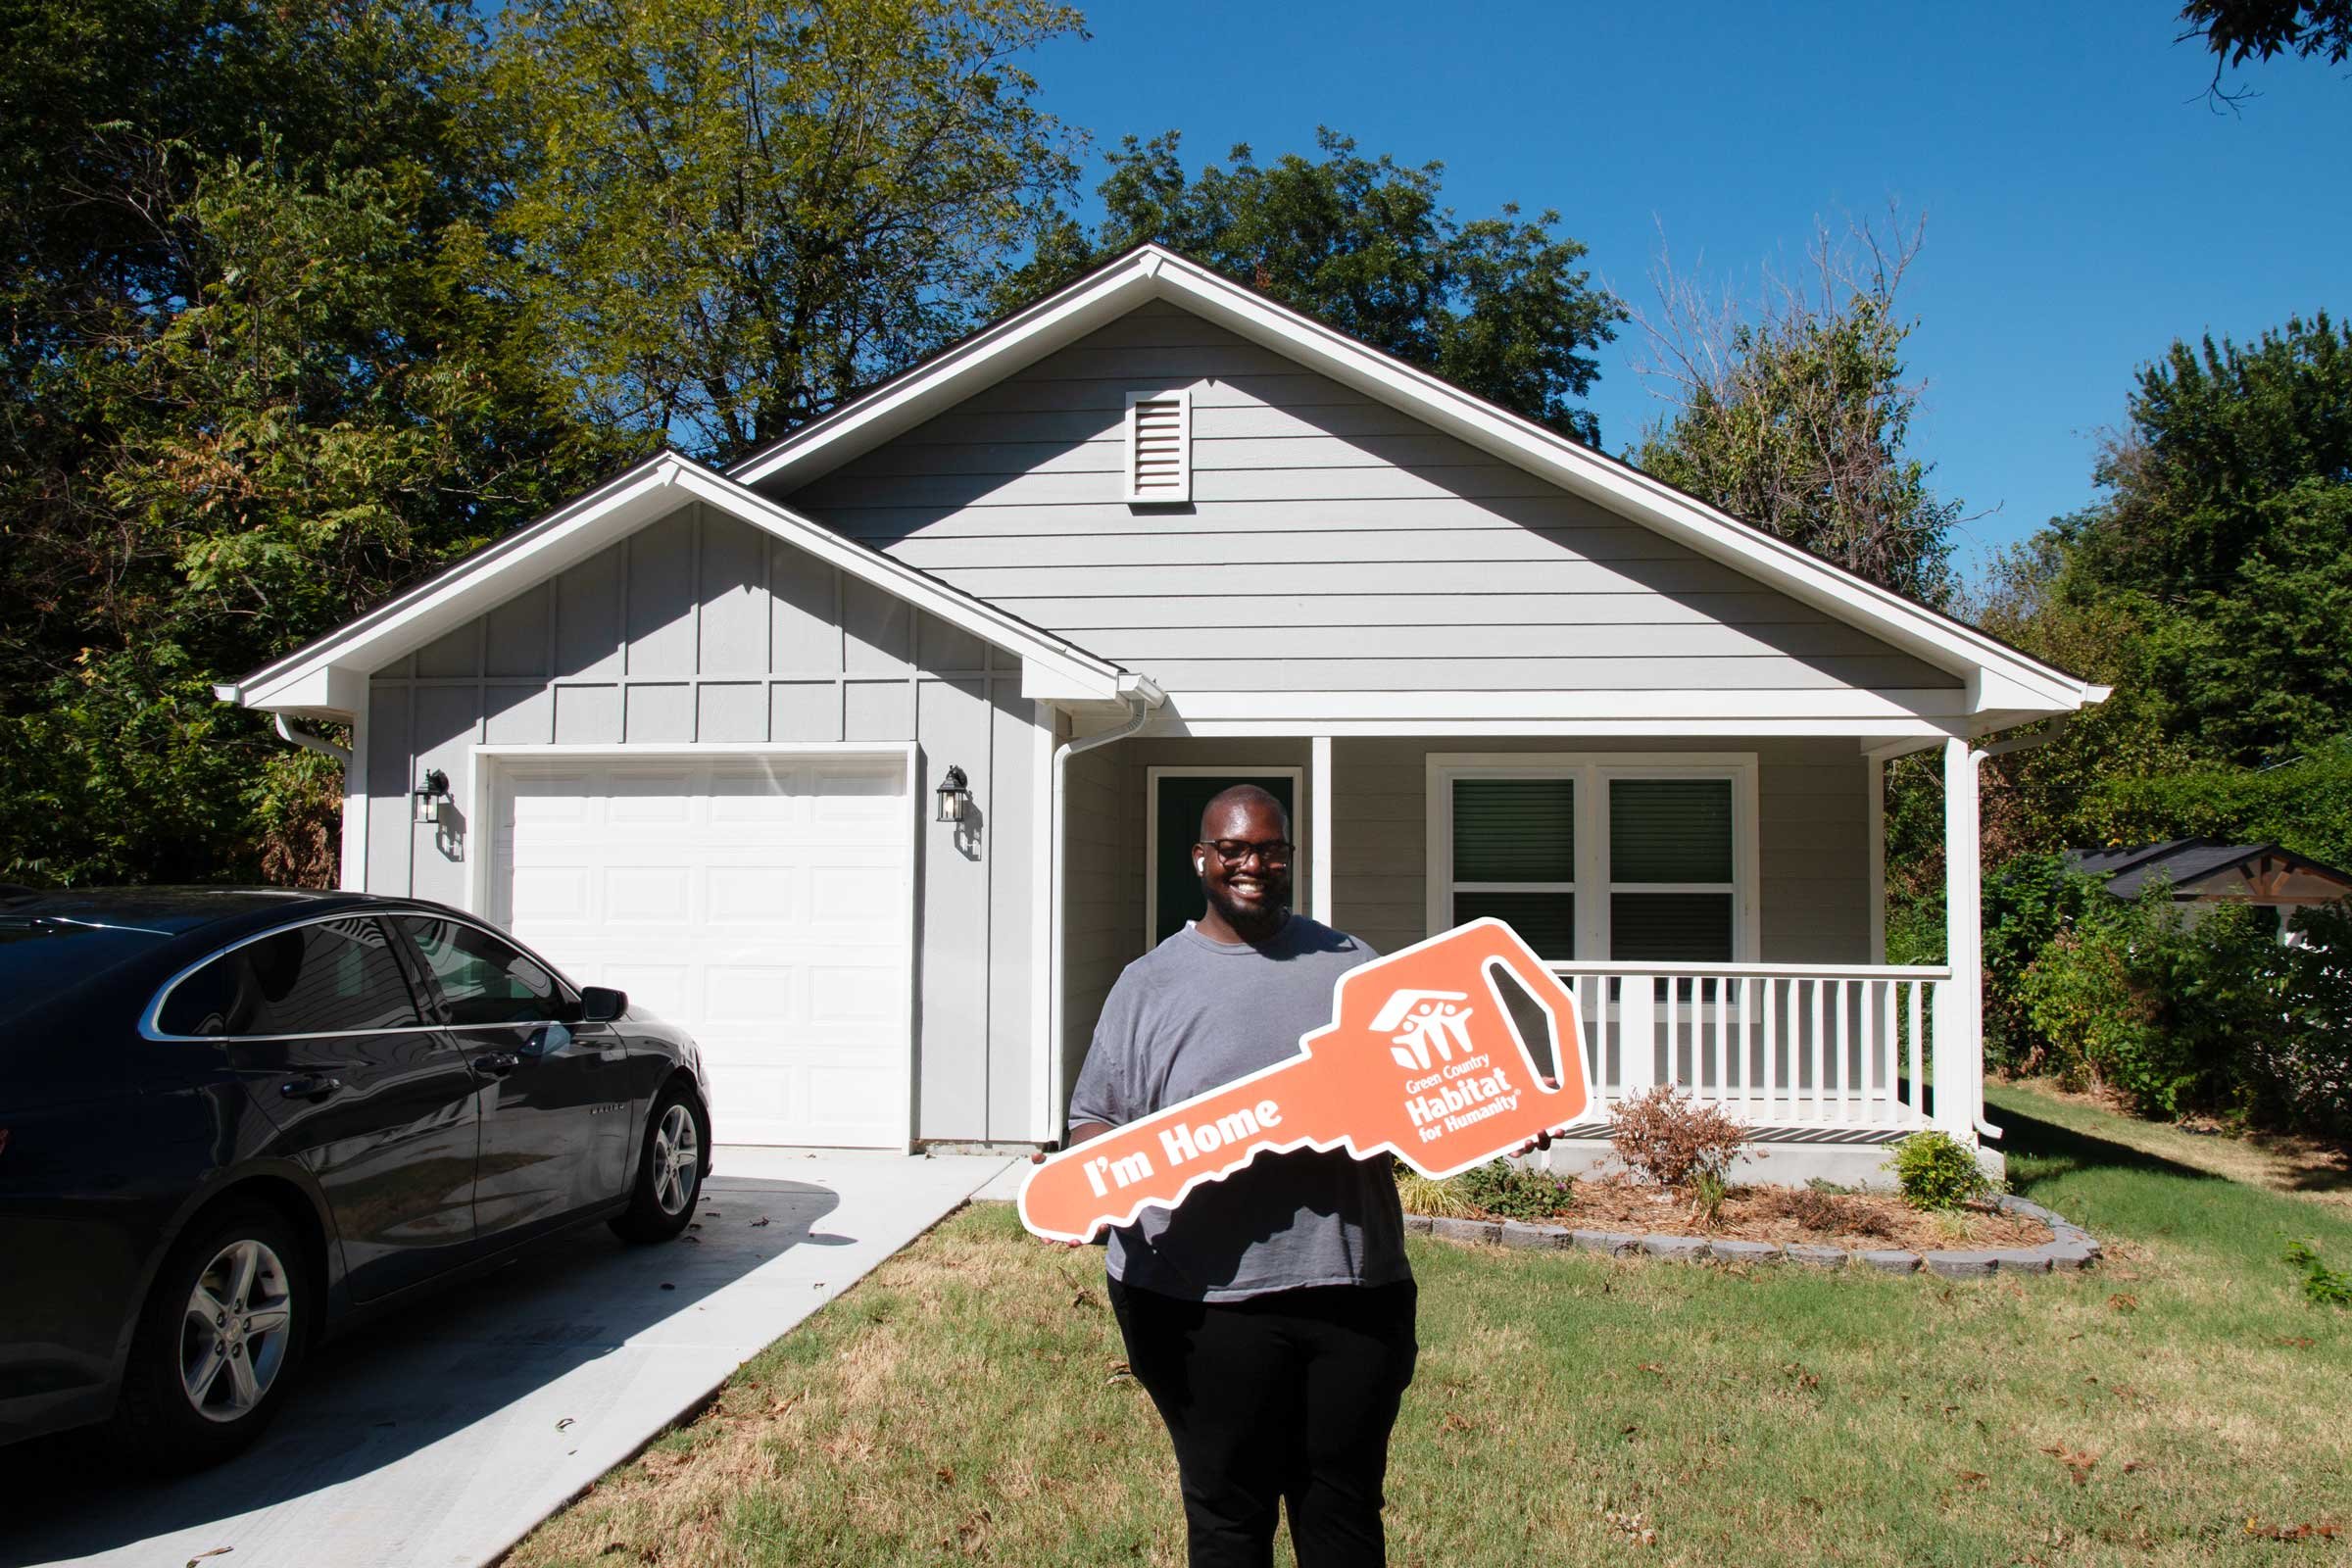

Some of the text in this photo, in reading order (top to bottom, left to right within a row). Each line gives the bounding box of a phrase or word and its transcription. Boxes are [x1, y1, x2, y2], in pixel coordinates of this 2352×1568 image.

[1404, 1066, 1512, 1127] Habitat
[1405, 1054, 1490, 1095] Green Country
[1082, 1100, 1283, 1199] I'm Home
[1418, 1125, 1443, 1144] for
